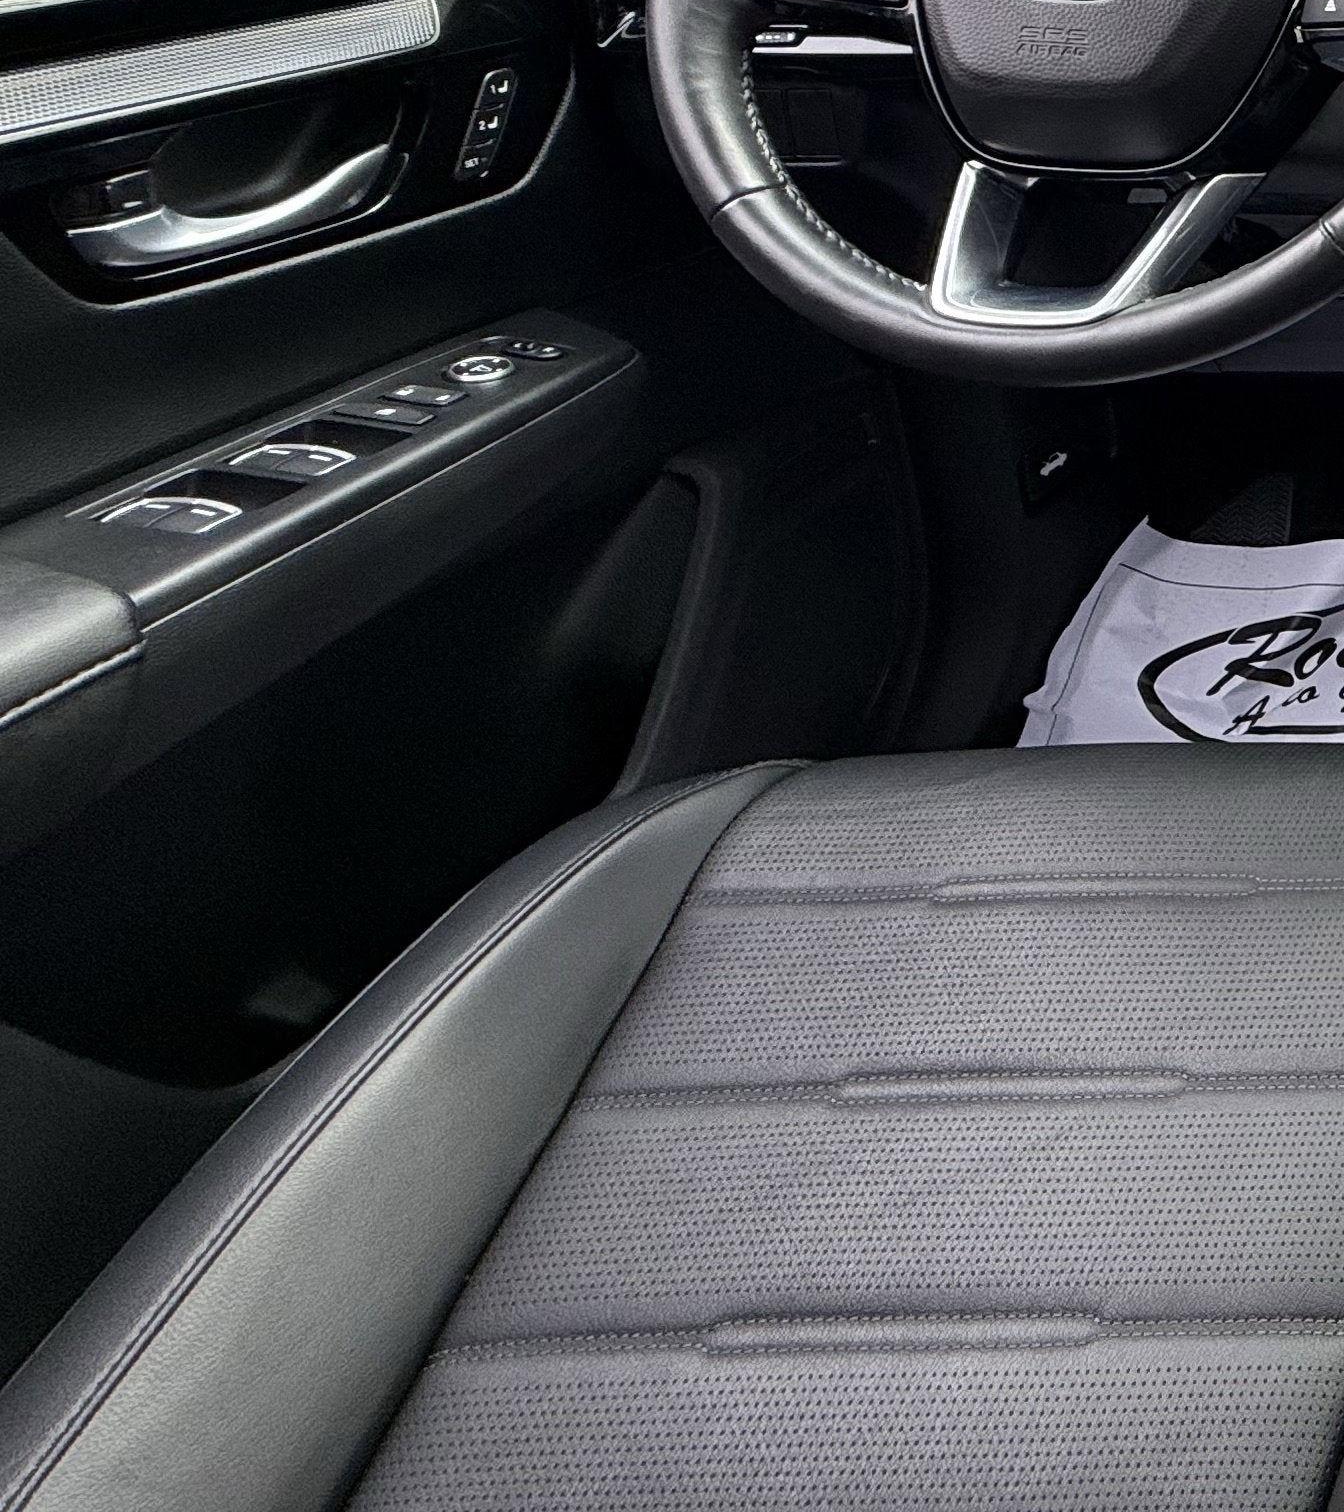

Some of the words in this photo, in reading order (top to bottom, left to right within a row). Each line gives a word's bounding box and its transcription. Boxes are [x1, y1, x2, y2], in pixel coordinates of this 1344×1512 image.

[490, 84, 497, 94] 1
[479, 120, 486, 130] 2
[464, 157, 479, 168] SET
